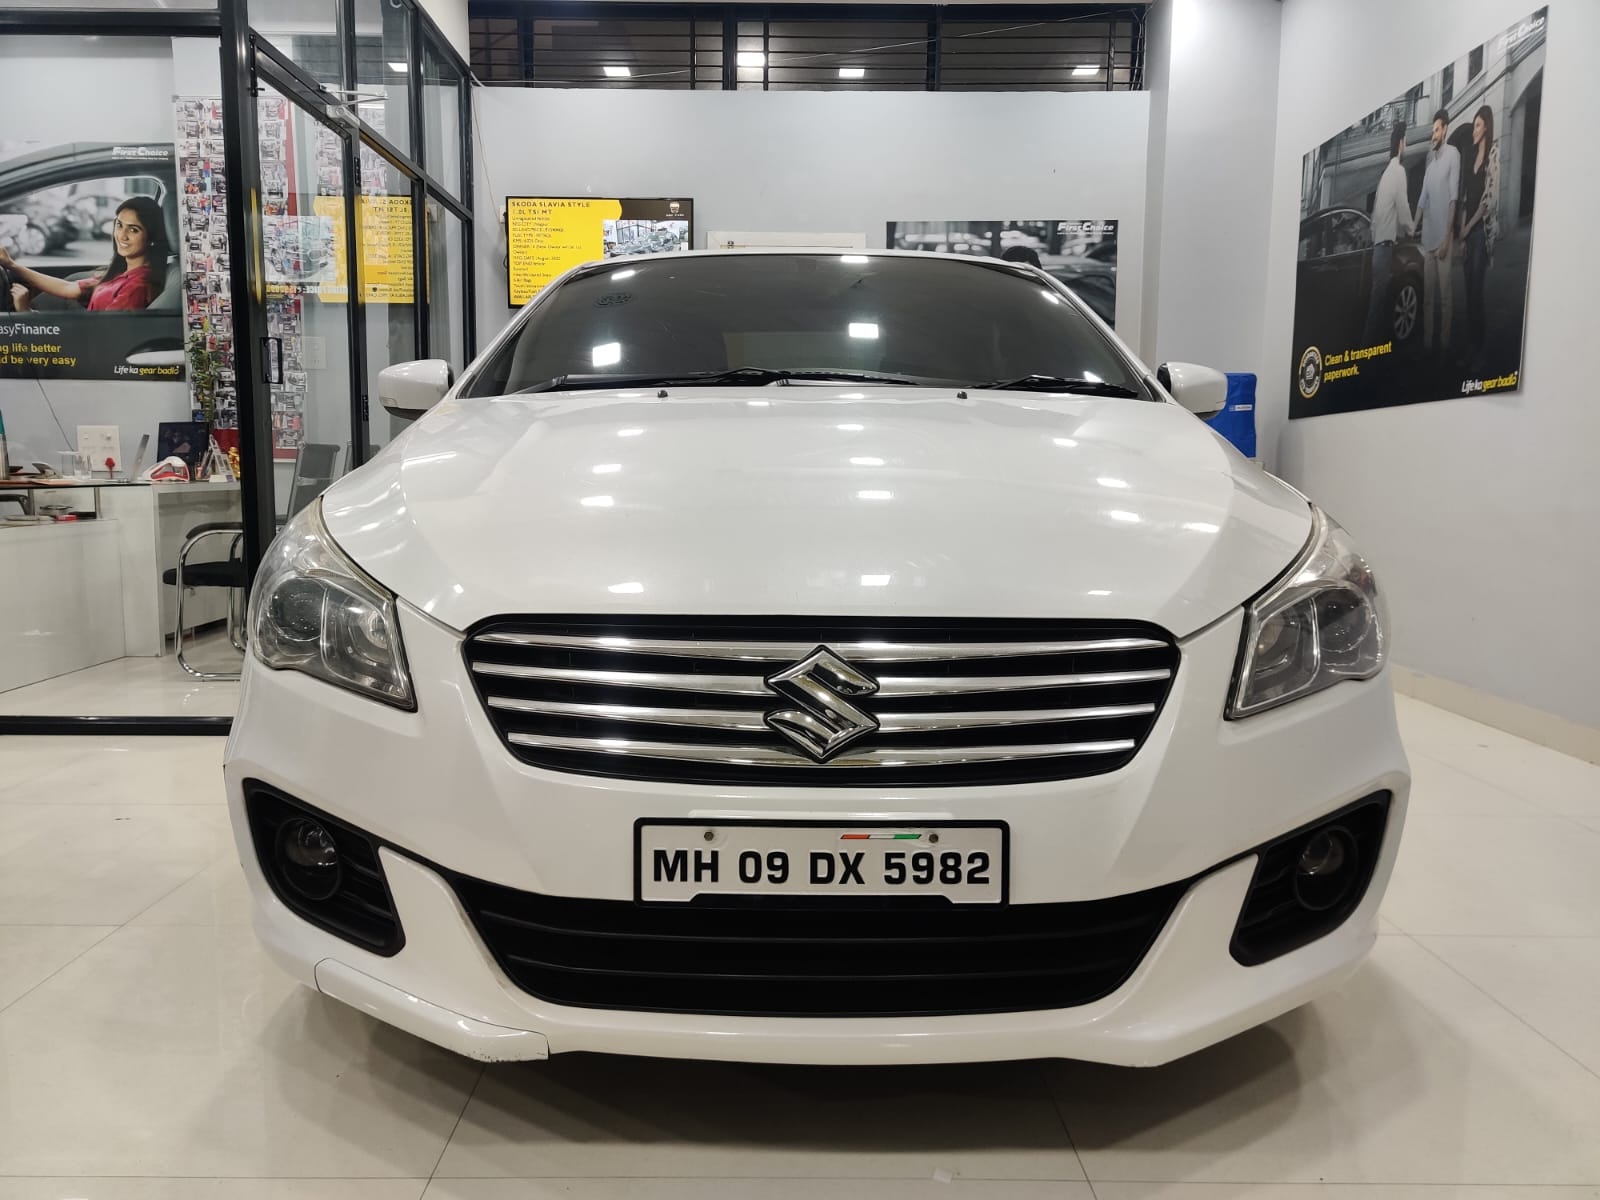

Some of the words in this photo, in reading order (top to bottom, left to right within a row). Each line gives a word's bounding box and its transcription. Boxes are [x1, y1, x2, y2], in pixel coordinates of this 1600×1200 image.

[137, 146, 168, 156] Choice
[12, 343, 28, 352] life
[31, 343, 61, 353] better
[1324, 354, 1343, 366] Clean
[1343, 350, 1350, 362] &
[1350, 341, 1393, 361] transparent
[11, 355, 24, 364] be
[27, 357, 49, 367] very
[52, 357, 76, 367] easy
[114, 365, 129, 375] Life
[129, 365, 139, 374] ka
[139, 367, 157, 376] gear
[1323, 364, 1360, 383] paperwork.
[1461, 380, 1474, 395] Life
[1474, 379, 1483, 391] ka
[1482, 379, 1498, 393] gear
[653, 849, 719, 883] MH
[738, 851, 789, 884] 09
[809, 852, 866, 885] DX
[884, 852, 990, 885] 5982
